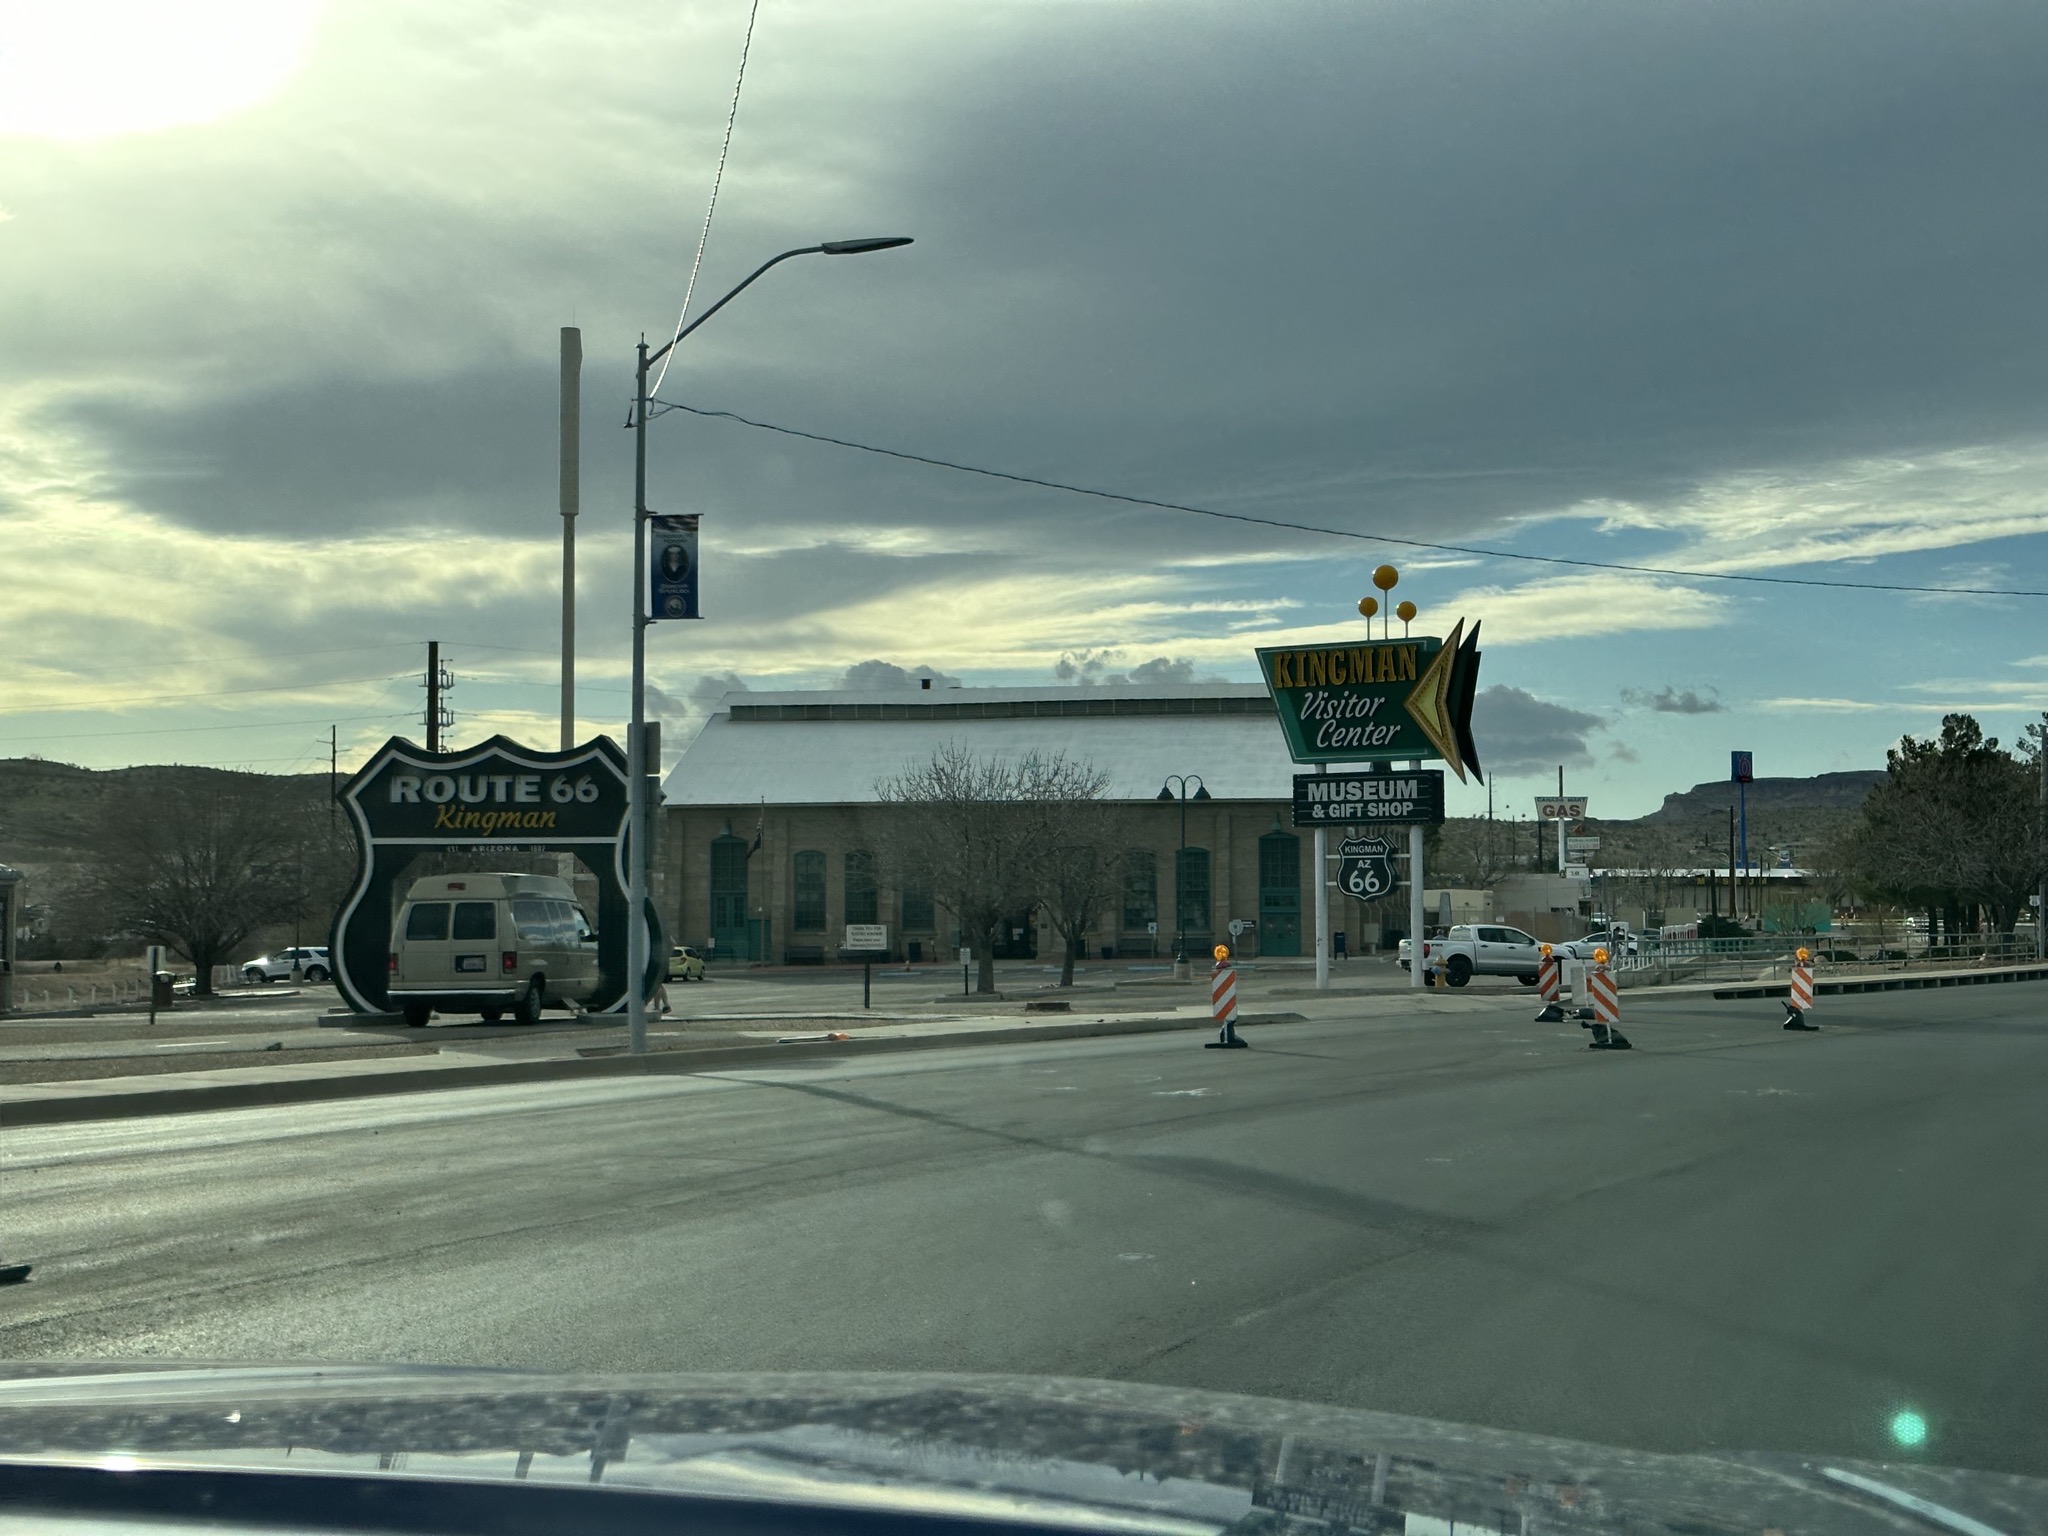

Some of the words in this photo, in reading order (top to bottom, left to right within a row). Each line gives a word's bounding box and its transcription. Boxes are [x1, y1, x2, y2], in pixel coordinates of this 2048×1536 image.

[1273, 644, 1417, 688] KINGMAN
[1300, 690, 1385, 720] Visitor
[1316, 719, 1401, 748] Center
[1738, 752, 1751, 776] 6
[390, 775, 542, 803] ROUTE
[550, 774, 600, 803] 66
[1307, 779, 1418, 802] MUSEUM
[434, 804, 556, 836] Kingman
[1312, 804, 1325, 818] &
[1328, 803, 1363, 818] GIFT
[1367, 801, 1414, 817] SHOP
[1542, 804, 1581, 817] GAS
[1344, 845, 1383, 854] KINGMAN
[1357, 860, 1371, 868] AZ
[1349, 870, 1380, 892] 66
